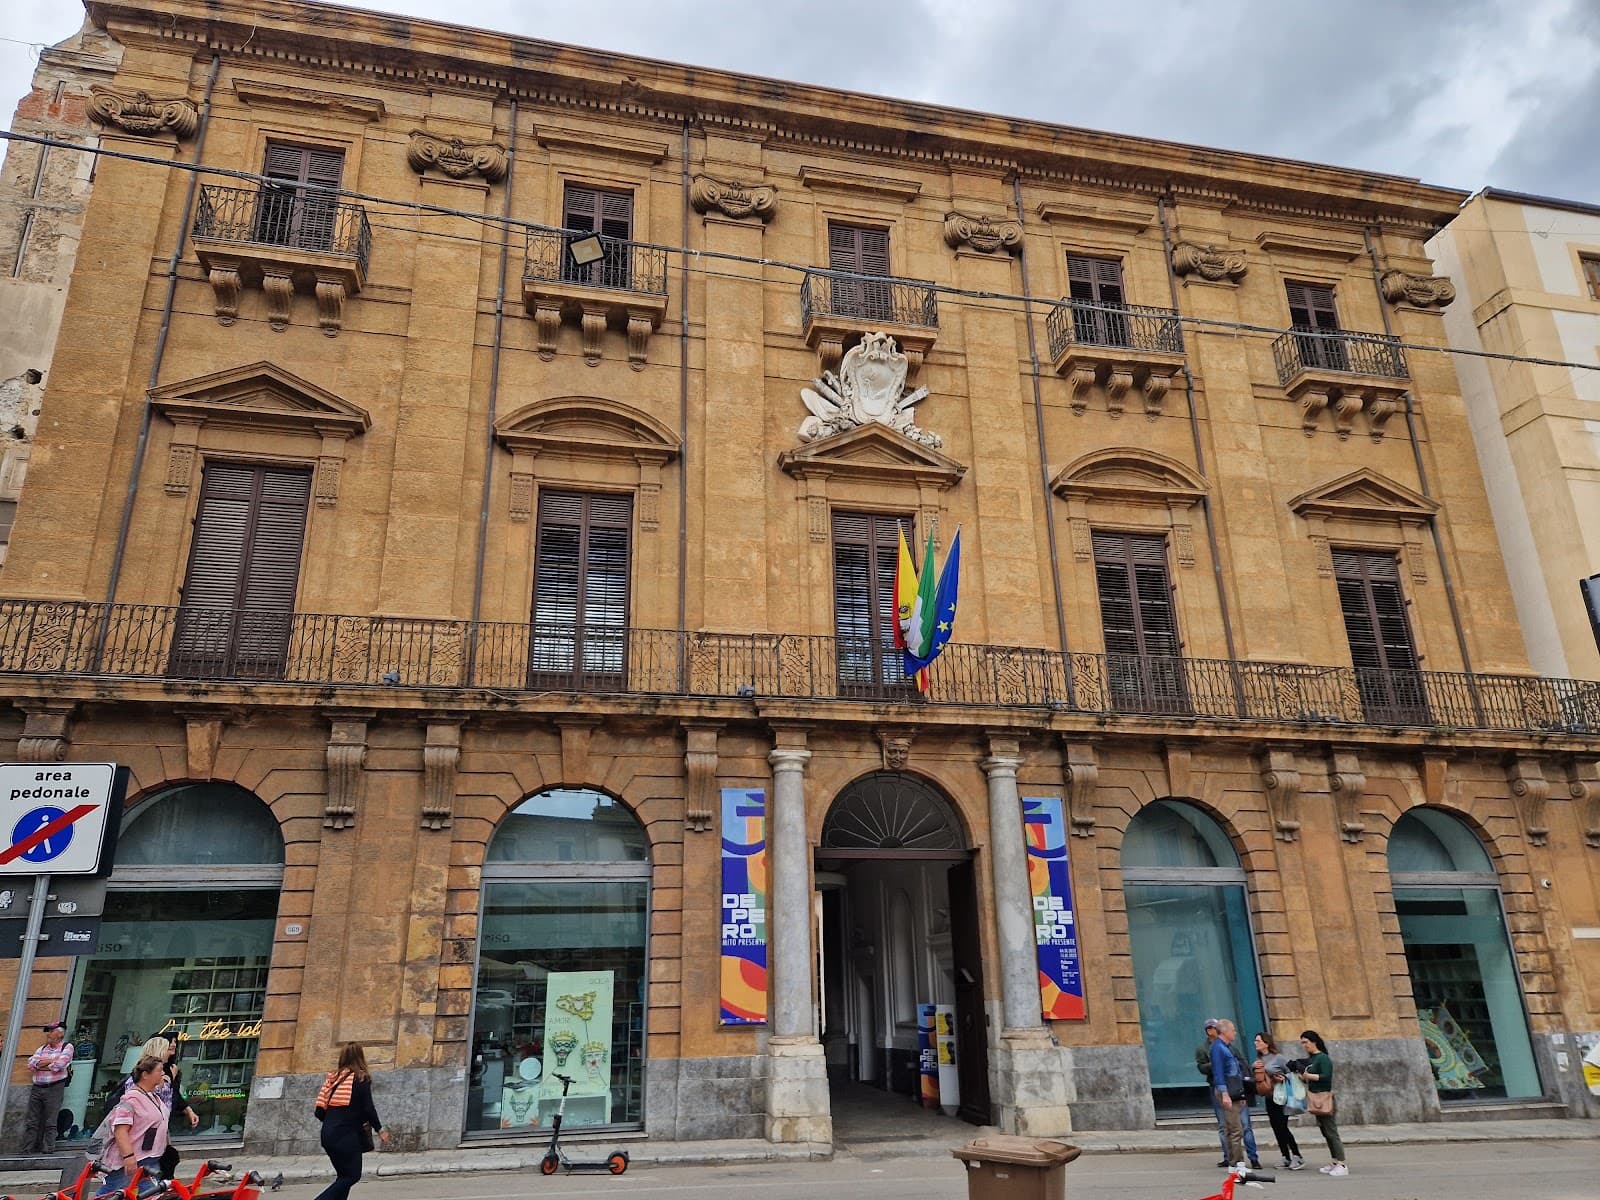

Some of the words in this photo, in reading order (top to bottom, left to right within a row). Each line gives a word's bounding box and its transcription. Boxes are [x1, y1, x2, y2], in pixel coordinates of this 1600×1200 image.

[35, 772, 72, 781] area
[10, 786, 90, 800] pedonale
[723, 894, 756, 908] DE
[1033, 897, 1064, 910] DE
[732, 909, 765, 923] PE
[1042, 911, 1073, 924] PE
[723, 924, 756, 938] RO
[1036, 925, 1066, 939] RO
[200, 1018, 232, 1039] the
